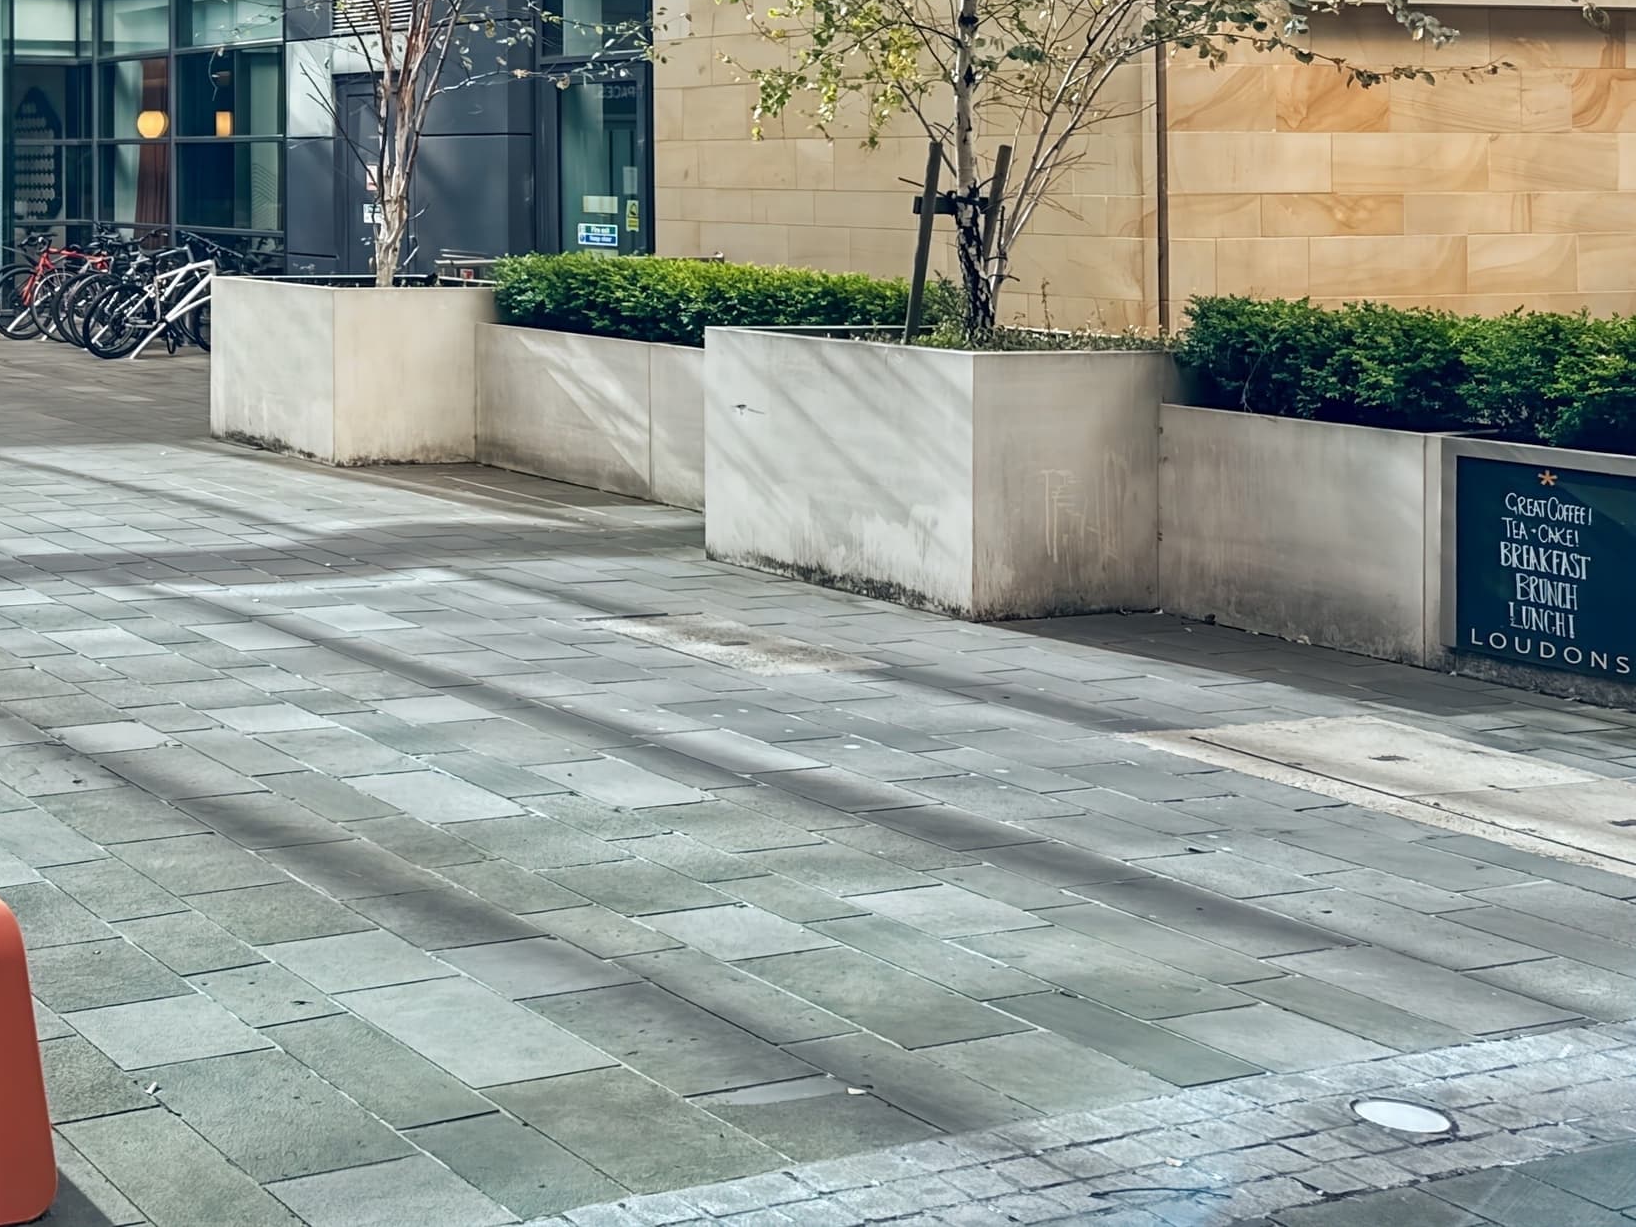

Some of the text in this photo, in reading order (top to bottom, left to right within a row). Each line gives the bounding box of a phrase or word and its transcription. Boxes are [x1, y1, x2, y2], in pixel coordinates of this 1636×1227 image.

[1505, 492, 1546, 518] GREAT
[1501, 517, 1529, 540] TEA
[1500, 541, 1591, 580] BREAKFAST
[1516, 573, 1578, 611] BRUNCH
[1470, 628, 1631, 674] LOUDONS
